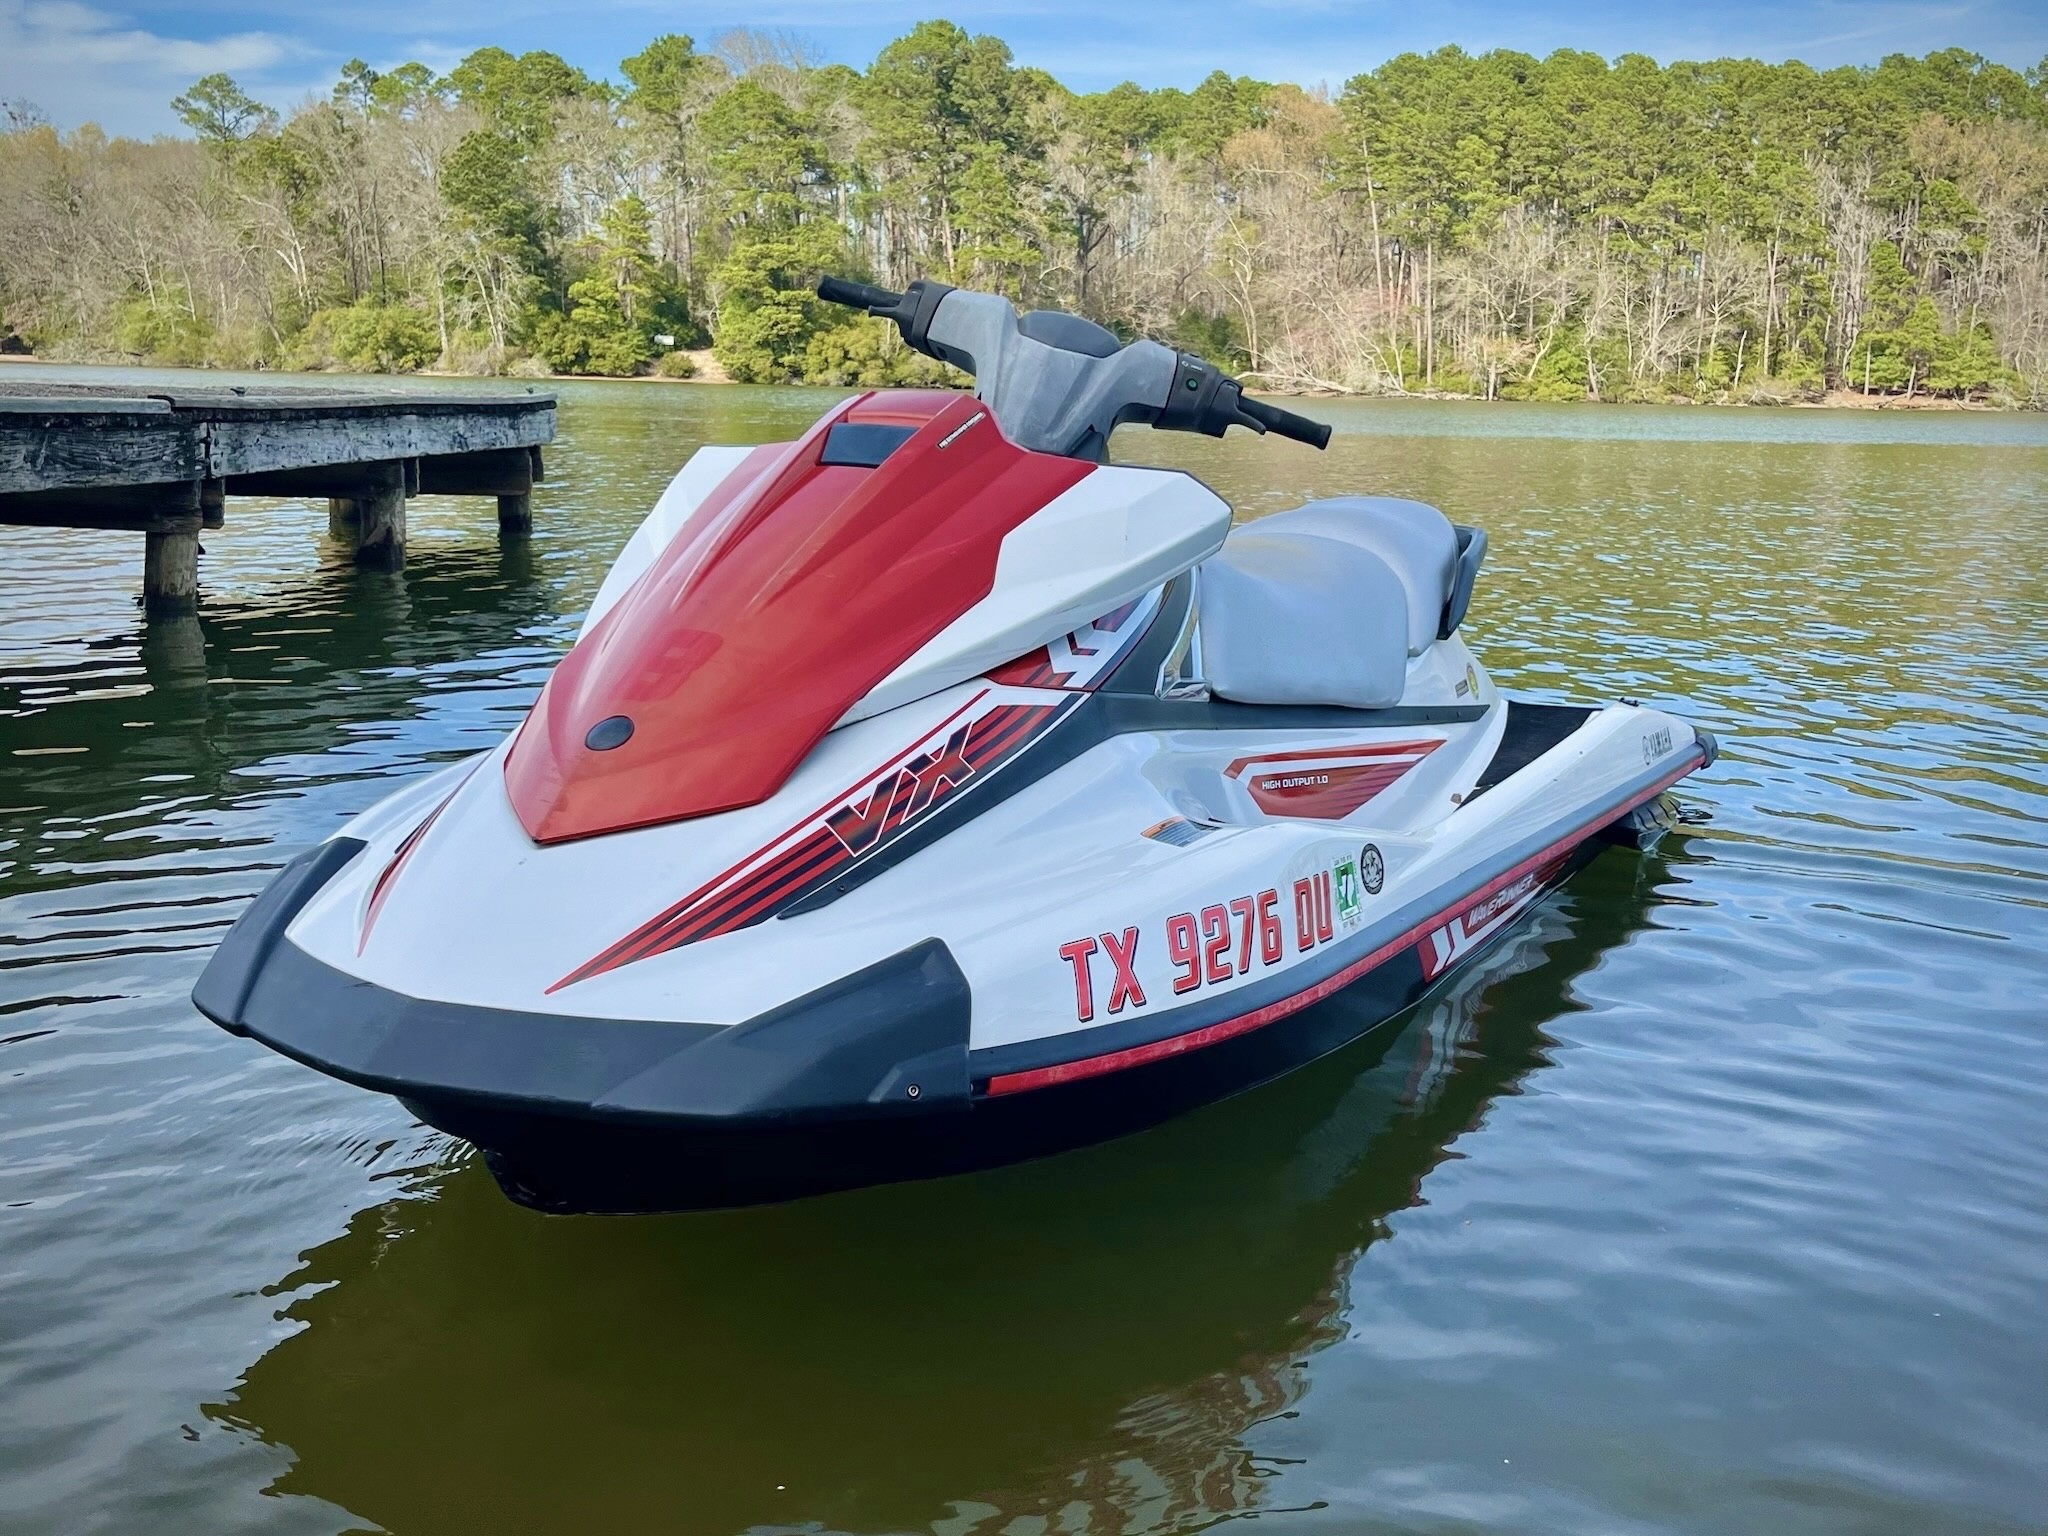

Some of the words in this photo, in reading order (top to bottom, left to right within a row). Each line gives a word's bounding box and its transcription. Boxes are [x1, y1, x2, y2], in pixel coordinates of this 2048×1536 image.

[825, 720, 976, 857] VX
[1261, 779, 1281, 790] HIGH
[1282, 776, 1315, 788] OUTPUT
[1316, 775, 1329, 785] 1.0
[1058, 926, 1147, 1023] TX
[1166, 888, 1283, 996] 9276
[1293, 870, 1335, 952] DU
